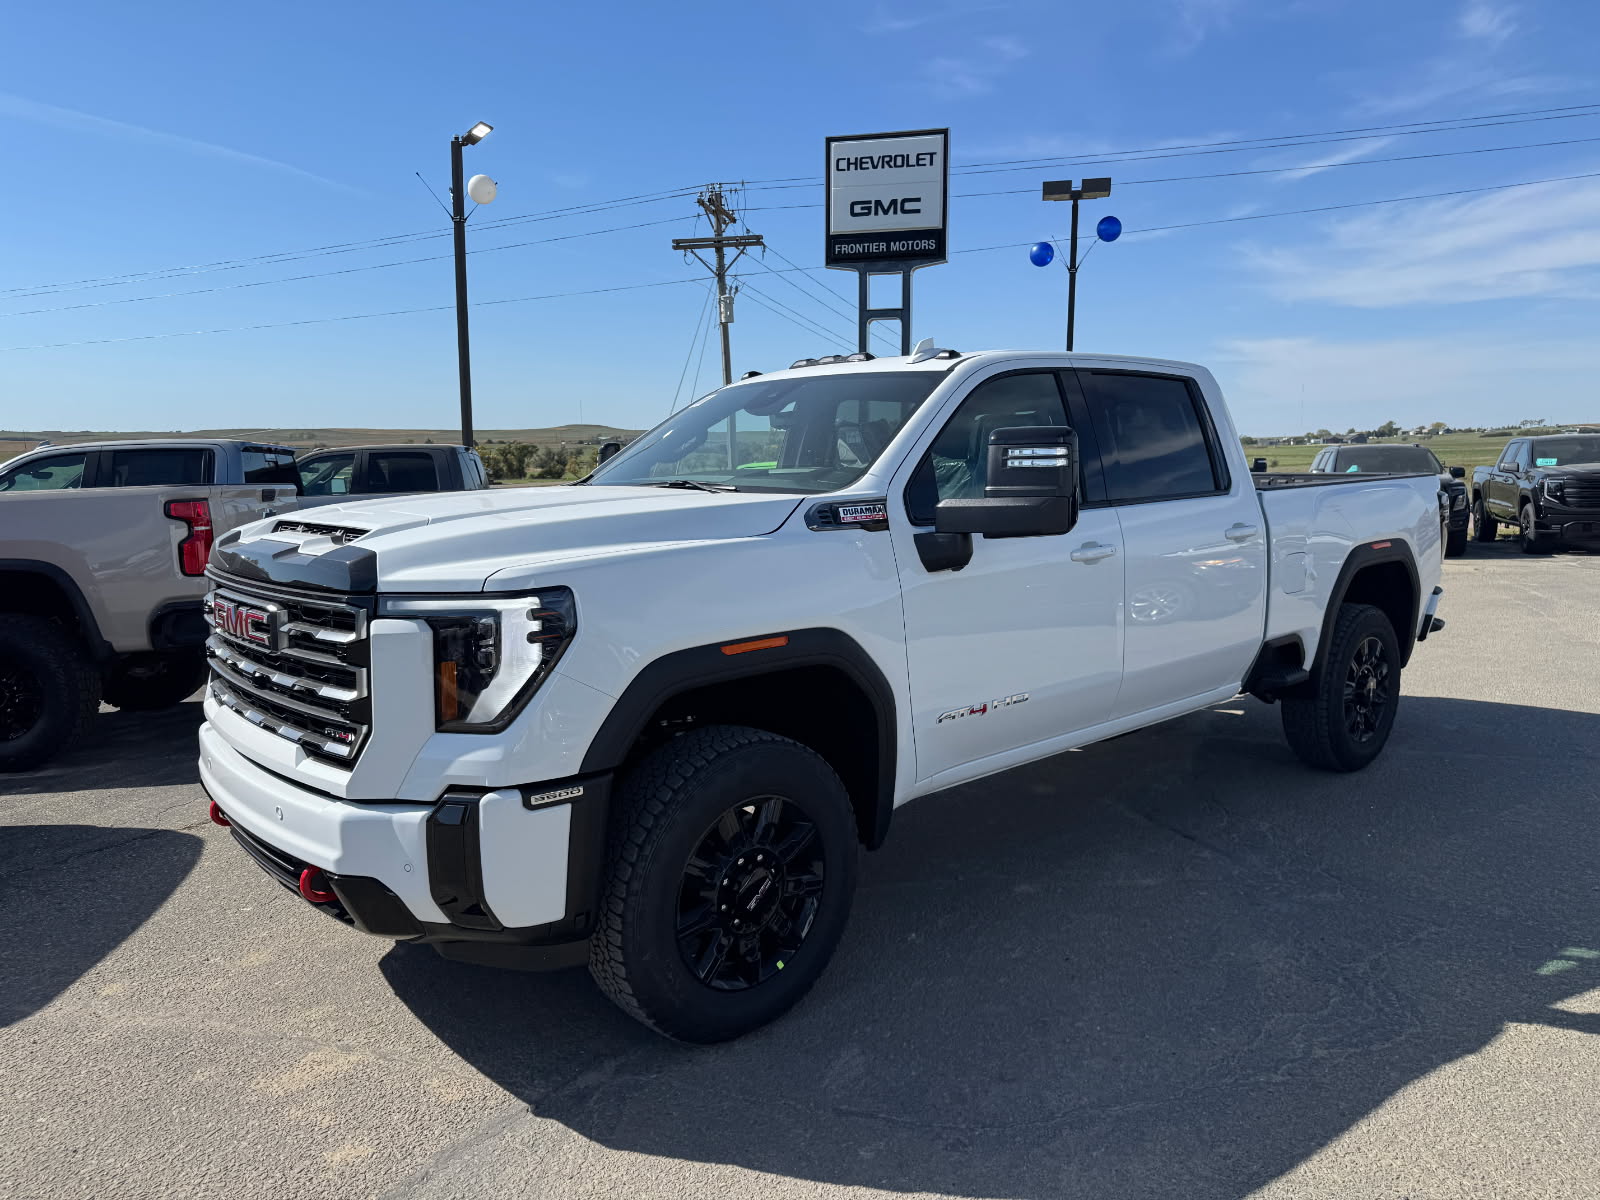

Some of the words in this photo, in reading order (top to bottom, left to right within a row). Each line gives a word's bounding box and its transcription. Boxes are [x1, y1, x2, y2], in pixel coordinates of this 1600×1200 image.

[836, 152, 937, 171] CHEVROLET
[850, 197, 921, 217] GMC
[835, 242, 887, 255] FRONTIER
[890, 239, 936, 252] MOTORS
[842, 506, 884, 515] DURAMAX
[213, 598, 270, 645] GMC
[936, 703, 988, 724] AT4
[992, 692, 1029, 709] HD
